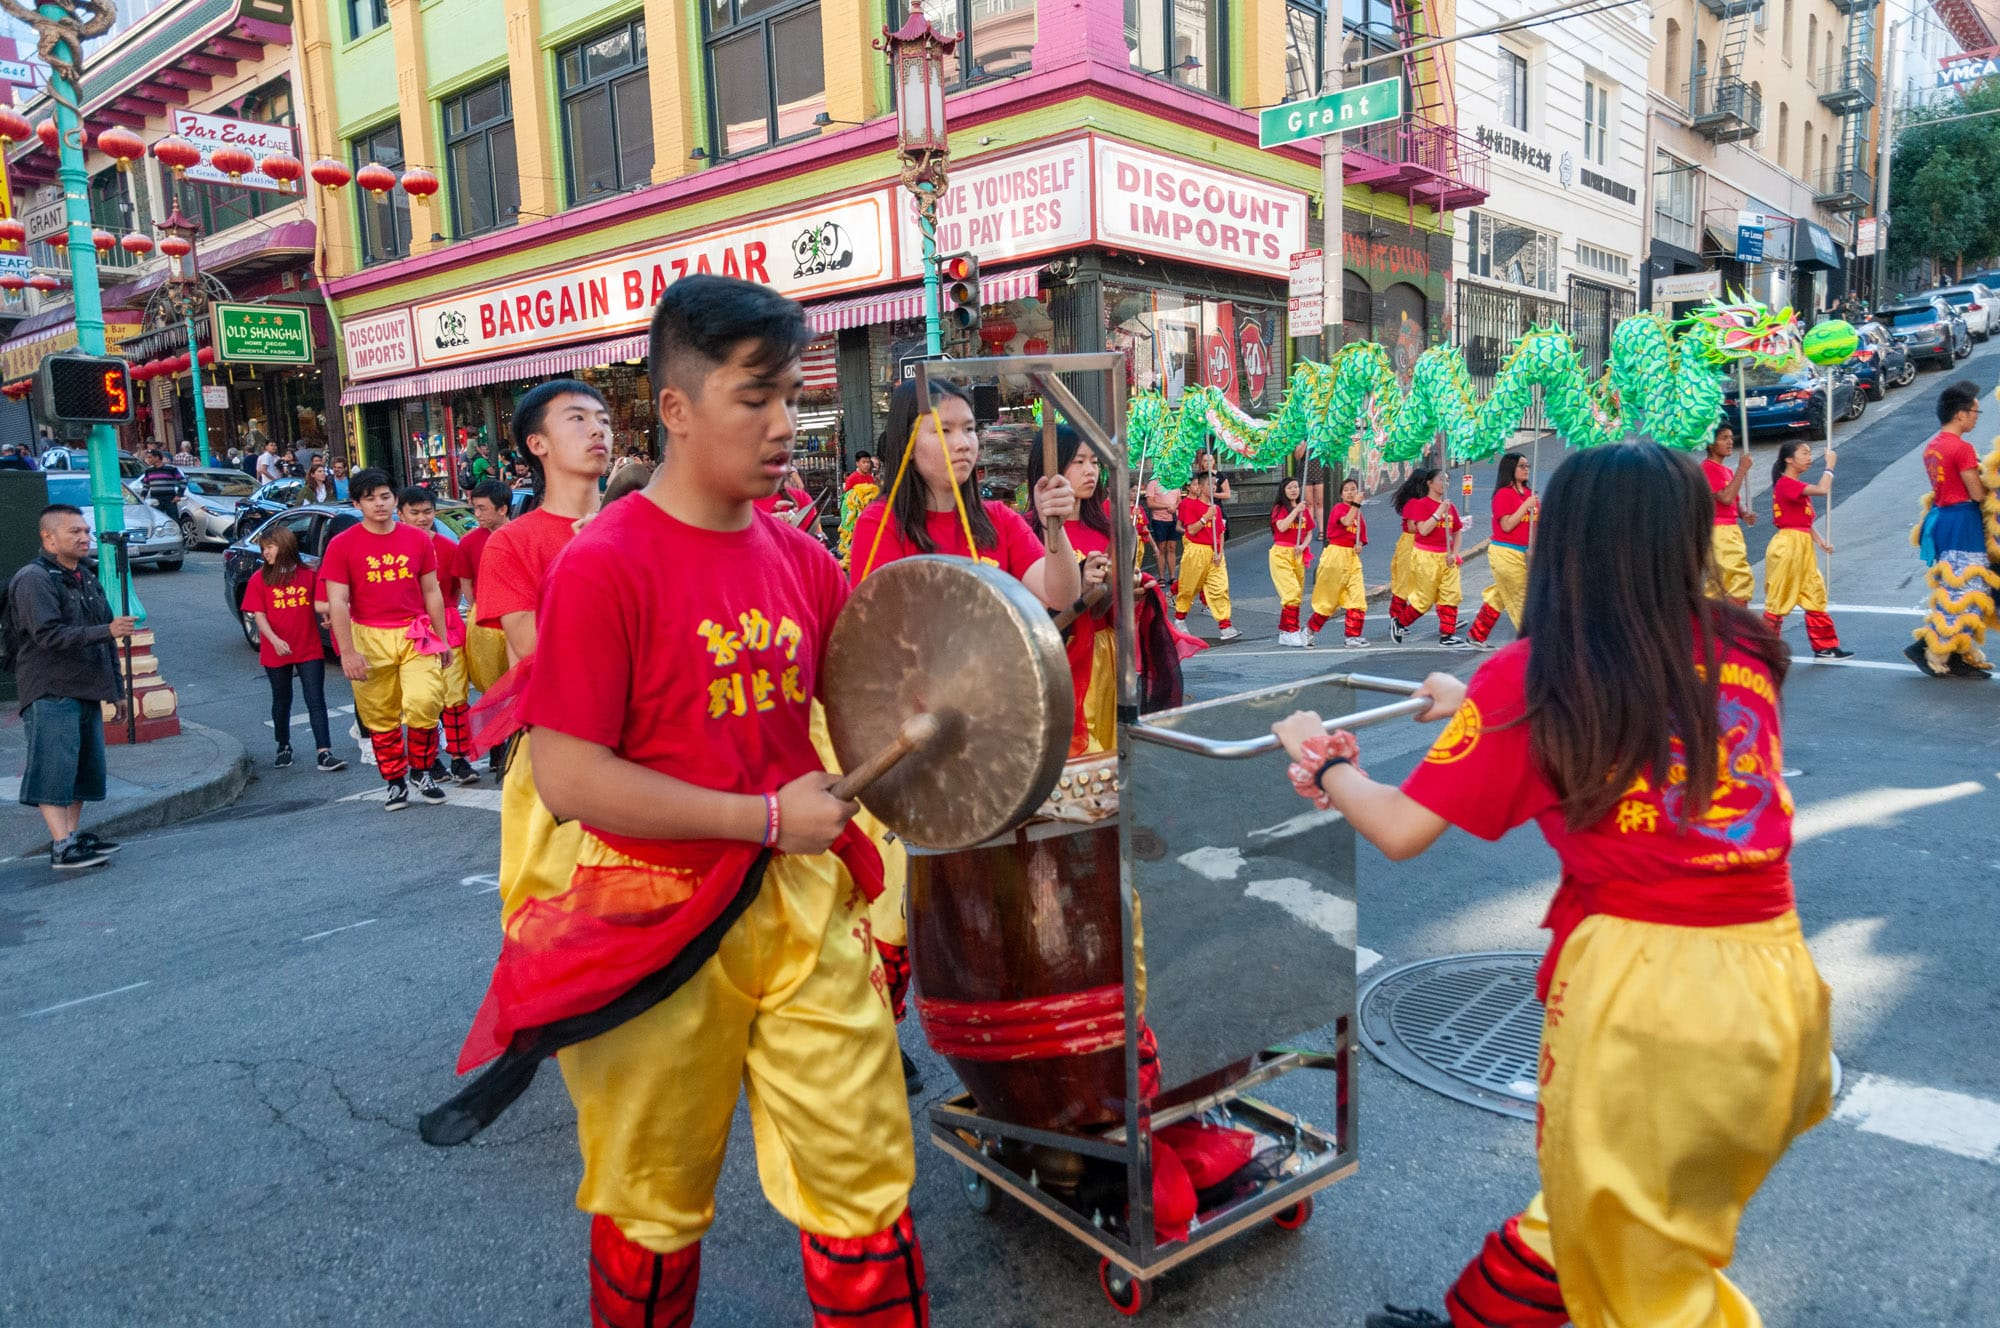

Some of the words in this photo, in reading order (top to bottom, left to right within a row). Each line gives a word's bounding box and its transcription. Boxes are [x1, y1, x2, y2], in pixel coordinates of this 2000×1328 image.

[1938, 60, 1999, 84] YMCA
[1287, 95, 1369, 132] Grant
[180, 116, 217, 140] Far
[221, 124, 267, 147] East
[973, 158, 1075, 210] YOURSELF
[1117, 161, 1289, 229] DISCOUNT
[29, 207, 62, 235] GRANT
[937, 222, 962, 253] ND
[969, 212, 1004, 247] PAY
[1011, 199, 1062, 239] LESS
[1130, 203, 1280, 260] IMPORTS
[1290, 259, 1299, 269] NO
[479, 276, 610, 340] BARGAIN
[1289, 300, 1298, 311] NO
[1300, 300, 1320, 309] PARKING
[111, 325, 126, 333] Bar
[227, 326, 247, 338] OLD
[250, 327, 302, 340] SHANGHAI
[350, 319, 406, 348] DISCOUNT
[355, 343, 406, 369] IMPORTS
[905, 366, 916, 377] ON
[105, 370, 127, 413] 5
